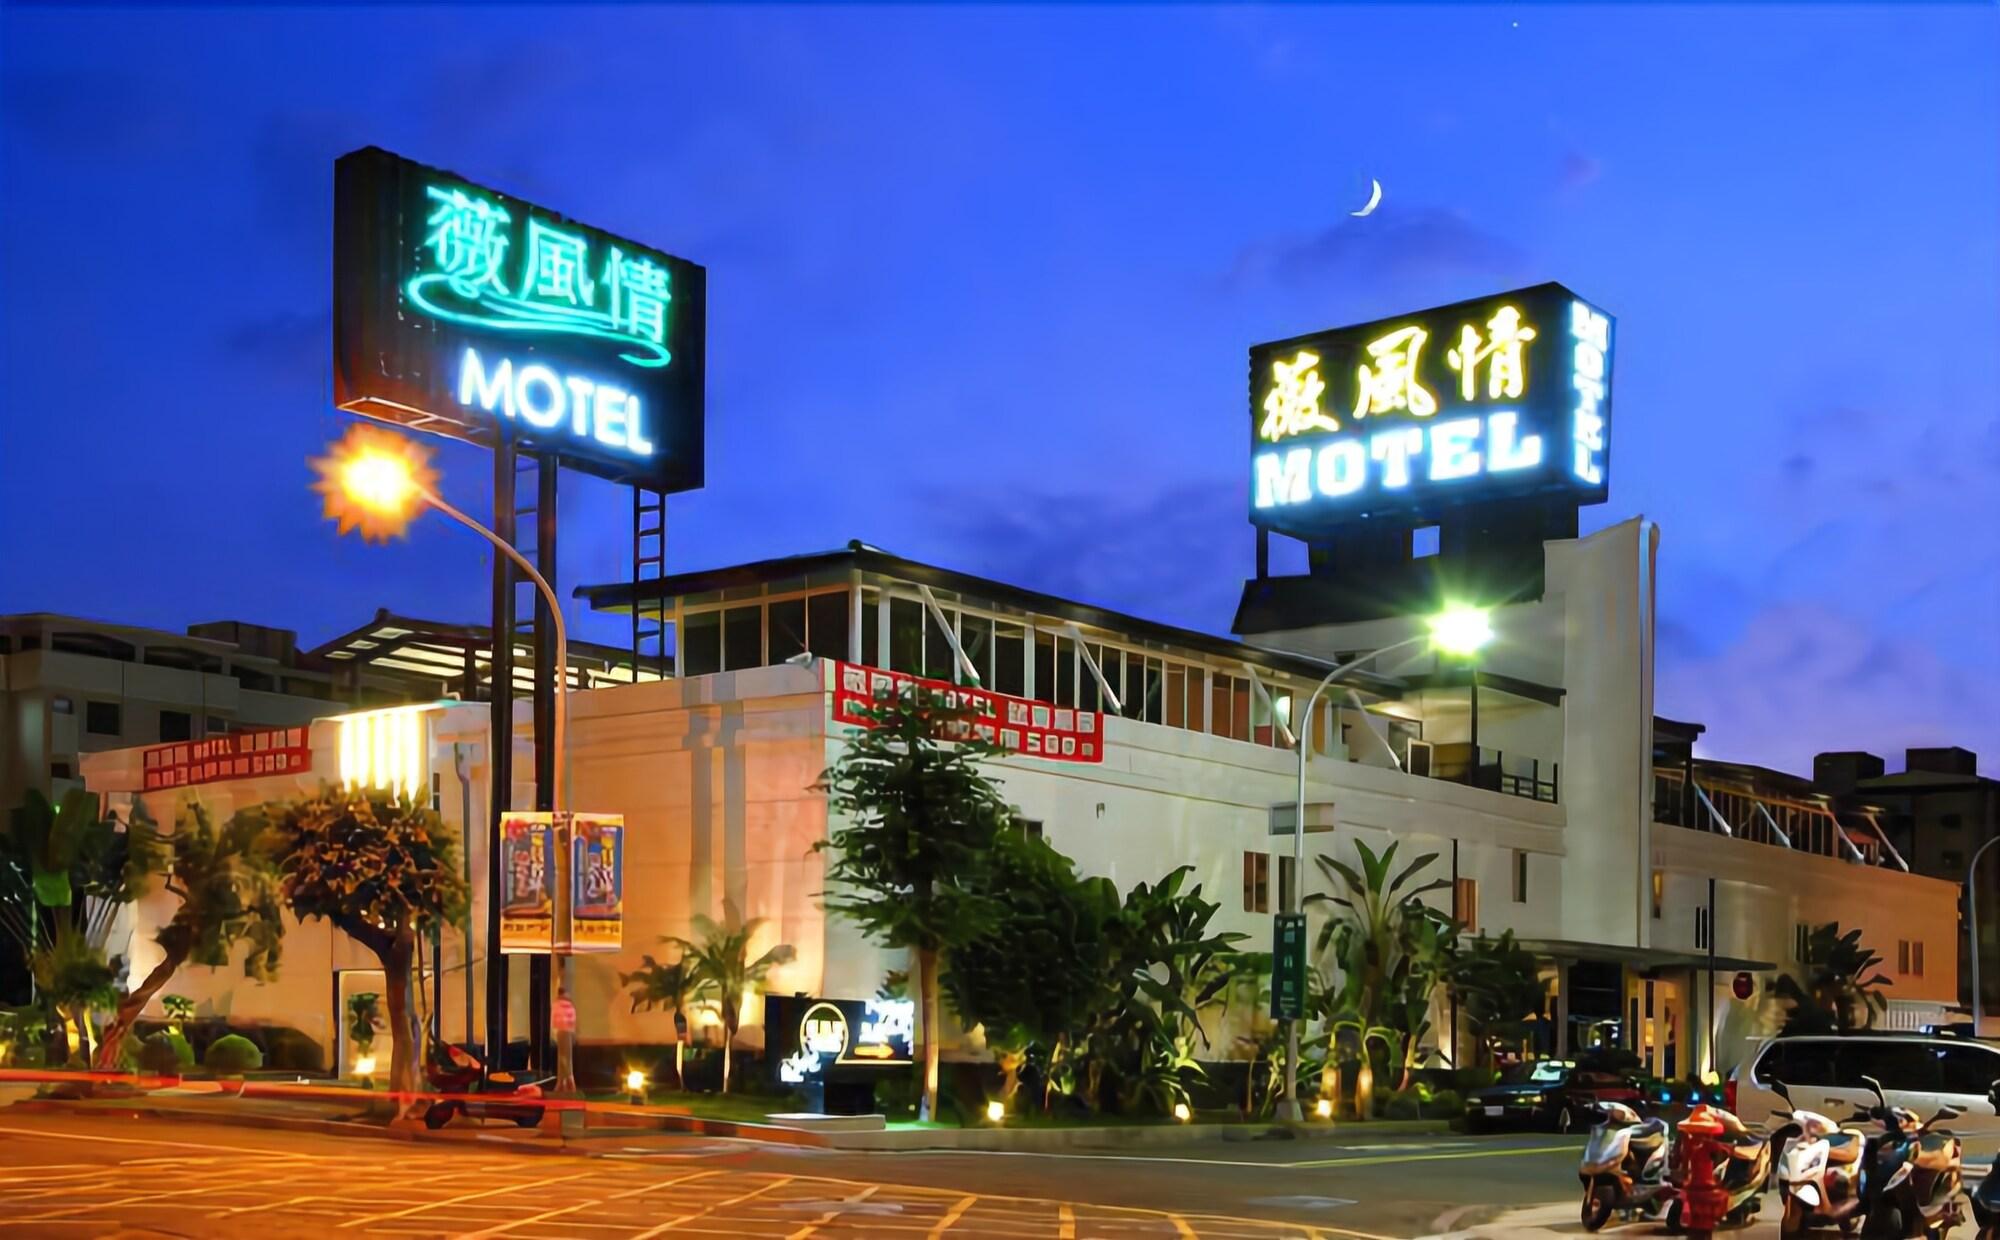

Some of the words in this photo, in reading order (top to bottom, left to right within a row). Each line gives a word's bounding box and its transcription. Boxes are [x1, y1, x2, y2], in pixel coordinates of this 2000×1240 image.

[425, 185, 672, 344] 薇風情
[458, 346, 654, 455] MOTEL
[1254, 411, 1542, 509] MOTEL
